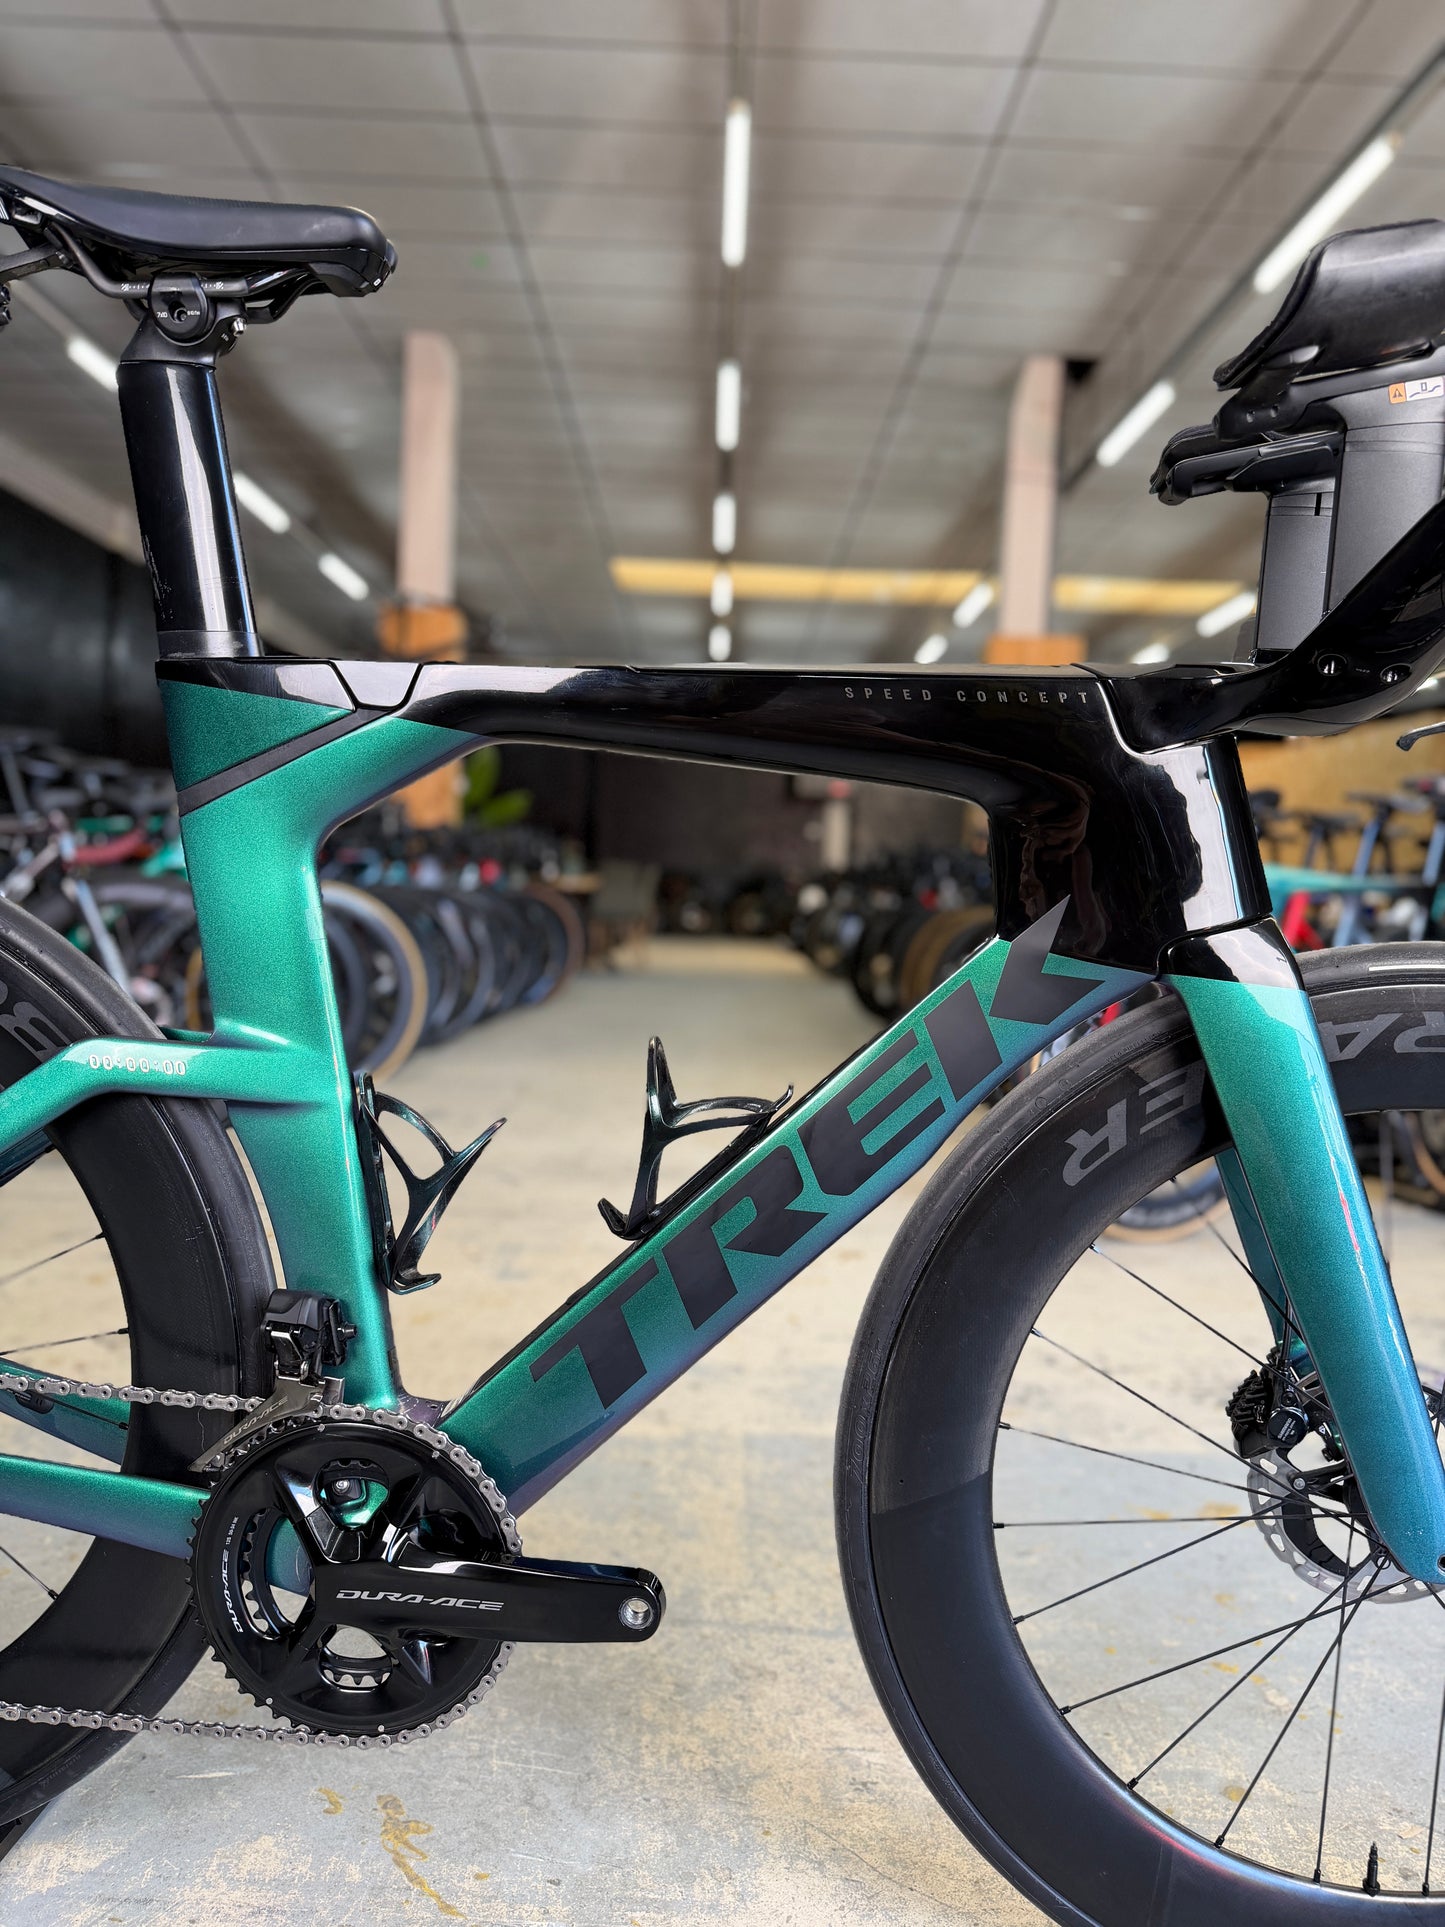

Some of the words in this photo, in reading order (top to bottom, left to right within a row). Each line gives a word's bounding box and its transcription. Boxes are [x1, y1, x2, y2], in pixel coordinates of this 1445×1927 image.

[844, 686, 932, 701] SPEED
[956, 690, 1087, 704] CONCEPT
[528, 894, 1106, 1410] TREK
[222, 1394, 289, 1445] DURA-ACE
[221, 1548, 244, 1633] DURA-ACE
[336, 1589, 505, 1611] DURA-ACE
